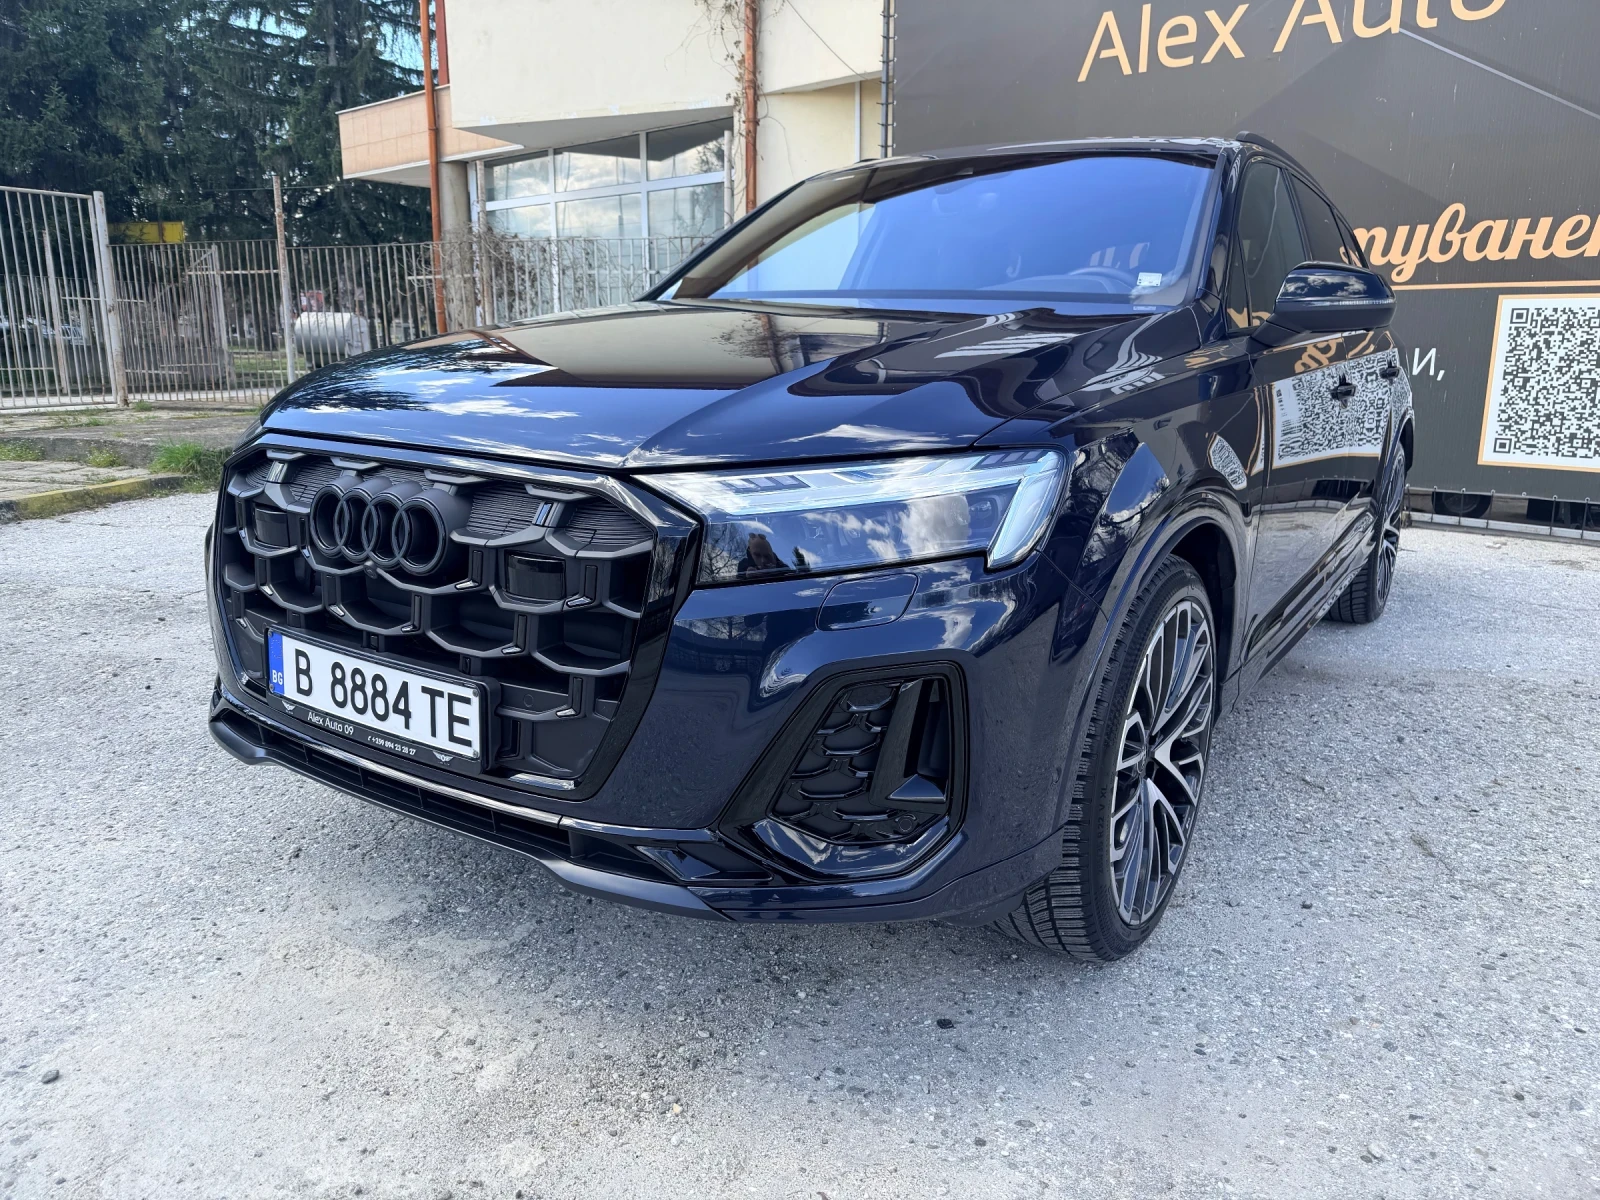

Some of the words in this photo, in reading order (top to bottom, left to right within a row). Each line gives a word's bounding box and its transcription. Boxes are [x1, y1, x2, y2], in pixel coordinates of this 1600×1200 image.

[1077, 3, 1249, 82] Alex
[1353, 203, 1600, 283] туване
[272, 669, 283, 686] BG
[294, 648, 313, 697] B
[330, 661, 412, 731] 8884
[421, 685, 473, 748] TE
[307, 711, 324, 726] Alex
[324, 717, 343, 732] Auto
[343, 725, 354, 736] 09
